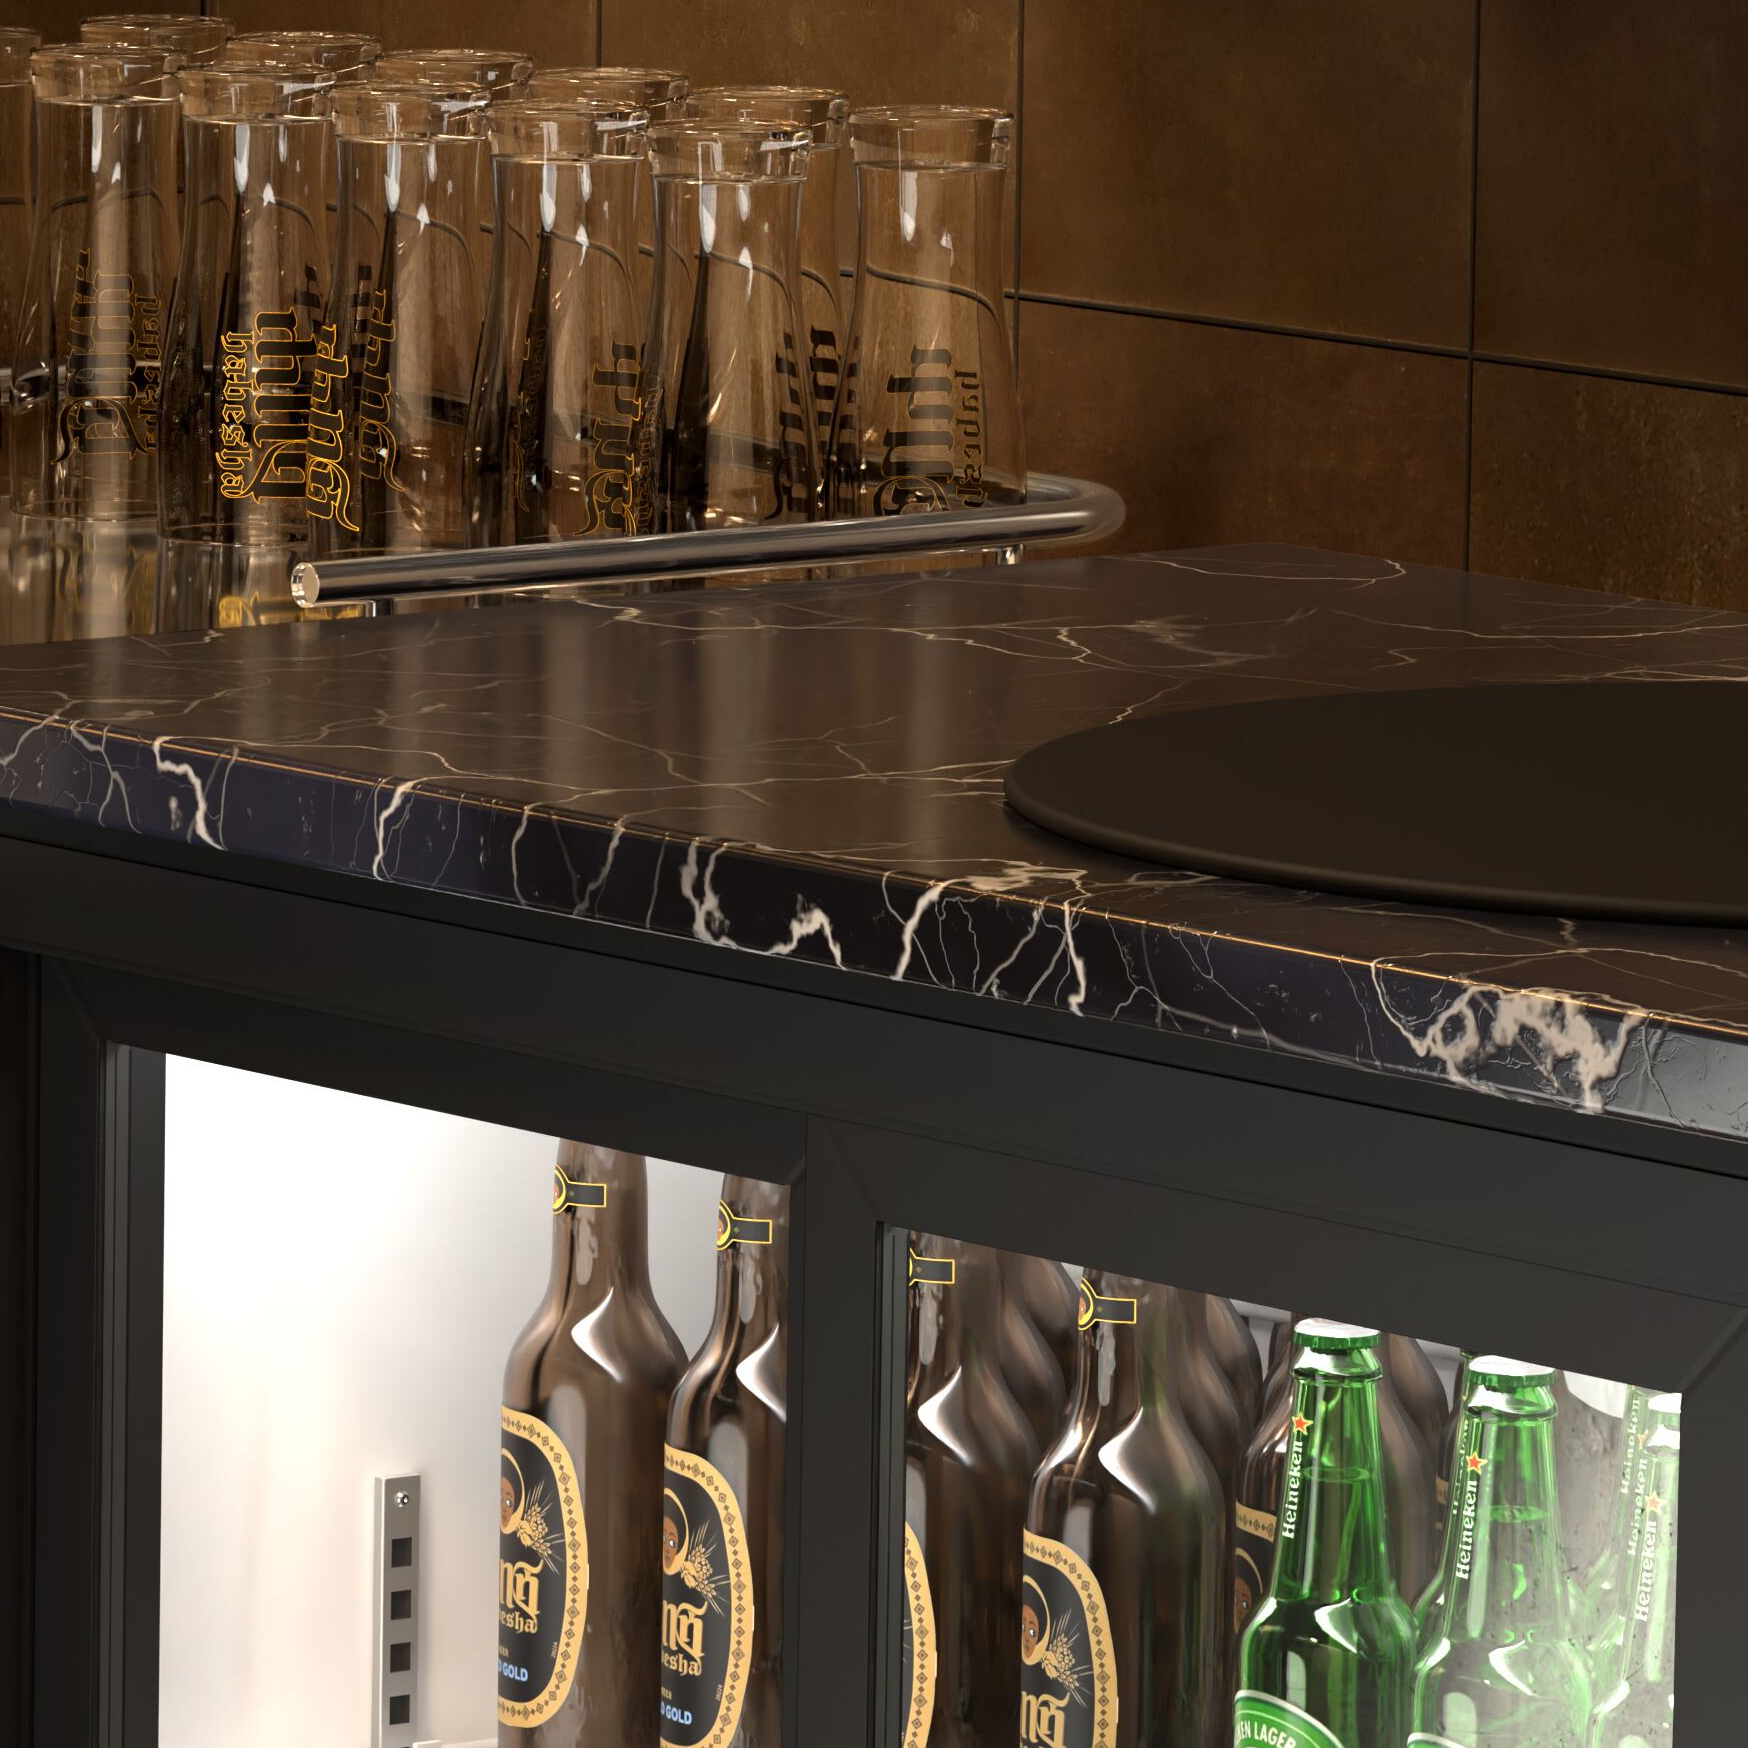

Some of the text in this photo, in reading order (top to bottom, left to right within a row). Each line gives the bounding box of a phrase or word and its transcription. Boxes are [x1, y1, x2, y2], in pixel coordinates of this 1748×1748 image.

[215, 332, 254, 499] habesha
[1282, 1441, 1303, 1539] Heineken
[1455, 1480, 1478, 1580] Heineken
[503, 1663, 529, 1683] GOLD
[665, 1707, 692, 1726] GOLD
